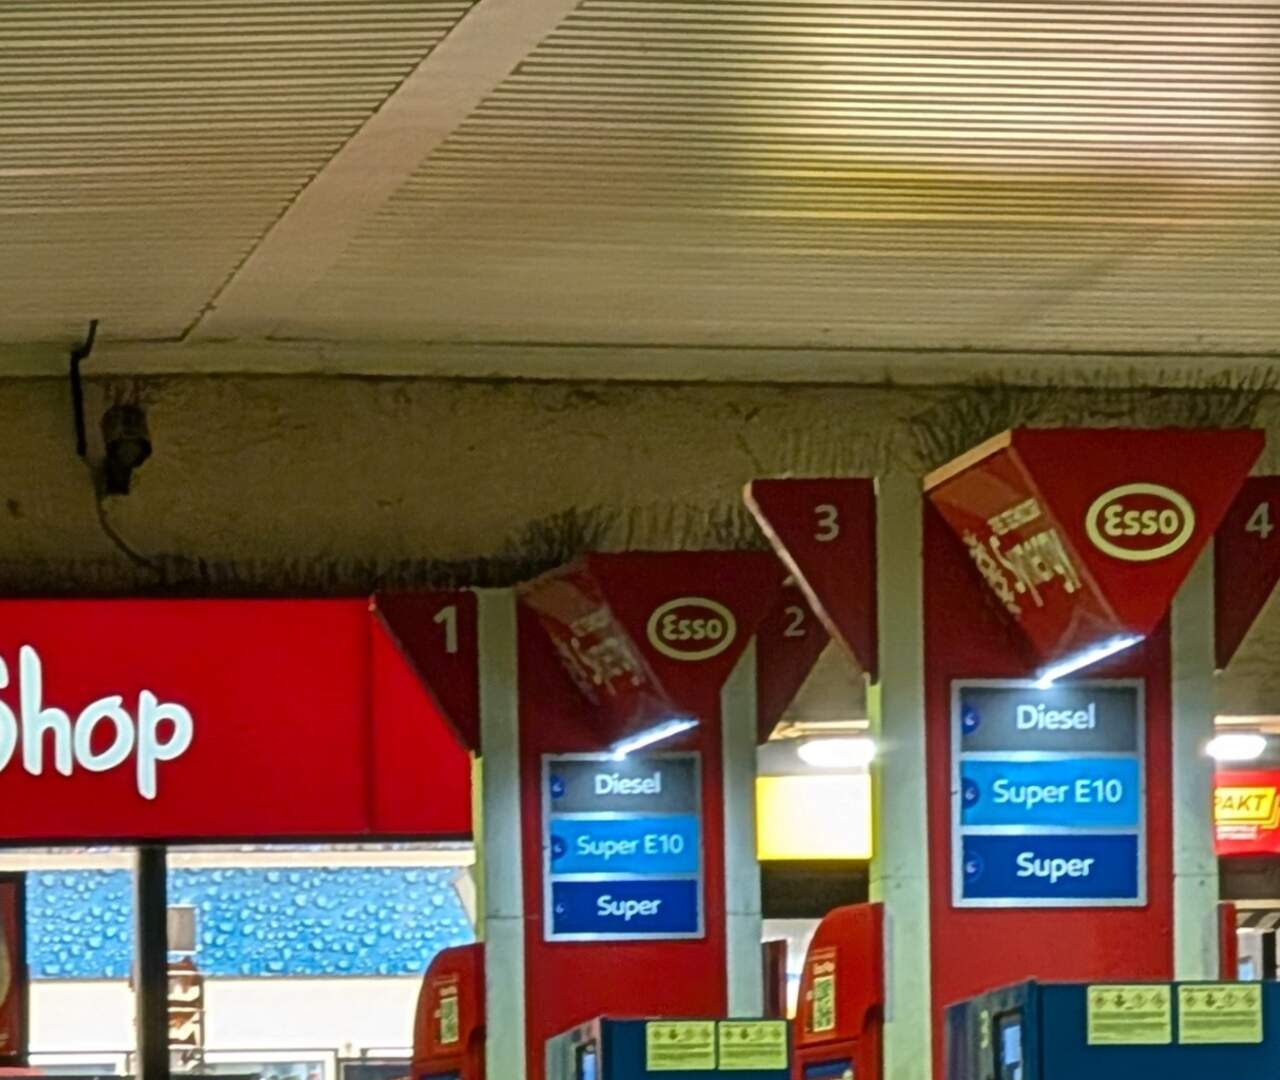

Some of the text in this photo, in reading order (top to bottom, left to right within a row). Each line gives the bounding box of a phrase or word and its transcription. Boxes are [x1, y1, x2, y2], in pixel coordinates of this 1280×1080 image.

[814, 504, 840, 541] 3
[1104, 505, 1179, 537] Esso
[1245, 502, 1274, 538] 4
[433, 606, 457, 653] 1
[662, 614, 722, 641] Esso
[784, 607, 806, 637] 2
[1016, 702, 1096, 730] Diesel
[594, 770, 662, 795] Diesel
[992, 779, 1123, 810] Super E10
[576, 834, 684, 861] Super E10
[1016, 851, 1095, 884] Super
[596, 894, 662, 921] Super
